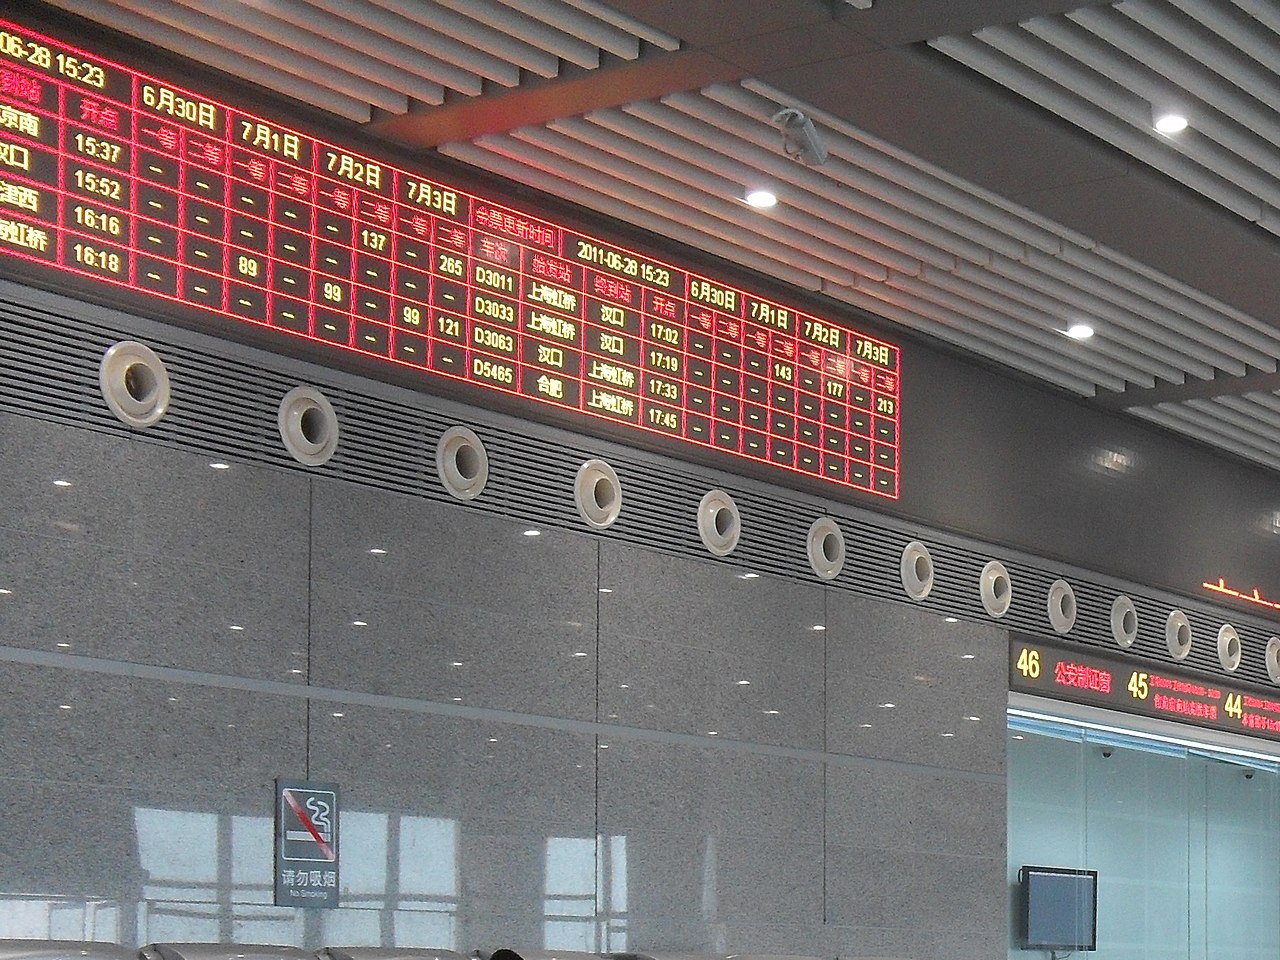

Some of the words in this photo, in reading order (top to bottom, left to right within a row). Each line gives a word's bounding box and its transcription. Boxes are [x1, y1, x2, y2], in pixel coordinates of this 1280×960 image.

[56, 54, 104, 88] 15:23
[144, 86, 215, 129] 6月30日
[241, 121, 300, 161] 7月1日
[326, 152, 382, 190] 7月2日
[407, 181, 457, 216] 7月3日
[75, 170, 120, 200] 15:52
[75, 134, 120, 162] 15:37
[362, 230, 386, 250] 137
[439, 255, 462, 276] 265
[73, 207, 120, 237] 16:16
[239, 256, 257, 276] 89
[324, 283, 341, 301] 99
[404, 307, 419, 325] 99
[439, 317, 458, 336] 121
[74, 244, 121, 273] 16:18
[577, 241, 638, 276] 2011-06-28
[641, 263, 670, 287] 15:23
[690, 280, 736, 312] 6月30日
[750, 302, 788, 330] 7月1日
[804, 321, 840, 349] 7月2日
[856, 340, 889, 366] 7月3日
[652, 295, 677, 318] 开点
[475, 296, 514, 323] D3033
[526, 311, 576, 341] 上海虹桥
[600, 333, 623, 355] 汉口
[651, 352, 677, 371] 17:19
[475, 266, 513, 292] D3011
[527, 281, 577, 312] 上海虹桥
[600, 304, 625, 328] 汉口
[650, 322, 679, 345] 17:02
[775, 364, 791, 380] 143
[827, 381, 843, 397] 177
[878, 398, 893, 414] 213
[474, 326, 513, 352] D3063
[538, 344, 564, 368] 汉口
[588, 360, 635, 389] 上海虹桥
[649, 378, 678, 401] 17:33
[473, 358, 513, 384] D5465
[537, 375, 563, 398] 合肥
[587, 389, 634, 417] 上海虹桥
[649, 409, 676, 428] 17:45
[1017, 649, 1039, 678] 46
[1128, 672, 1148, 699] 45
[1225, 693, 1242, 718] 44
[282, 869, 336, 888] 请勿吸烟
[290, 890, 300, 898] No
[301, 890, 328, 900] Smoking
